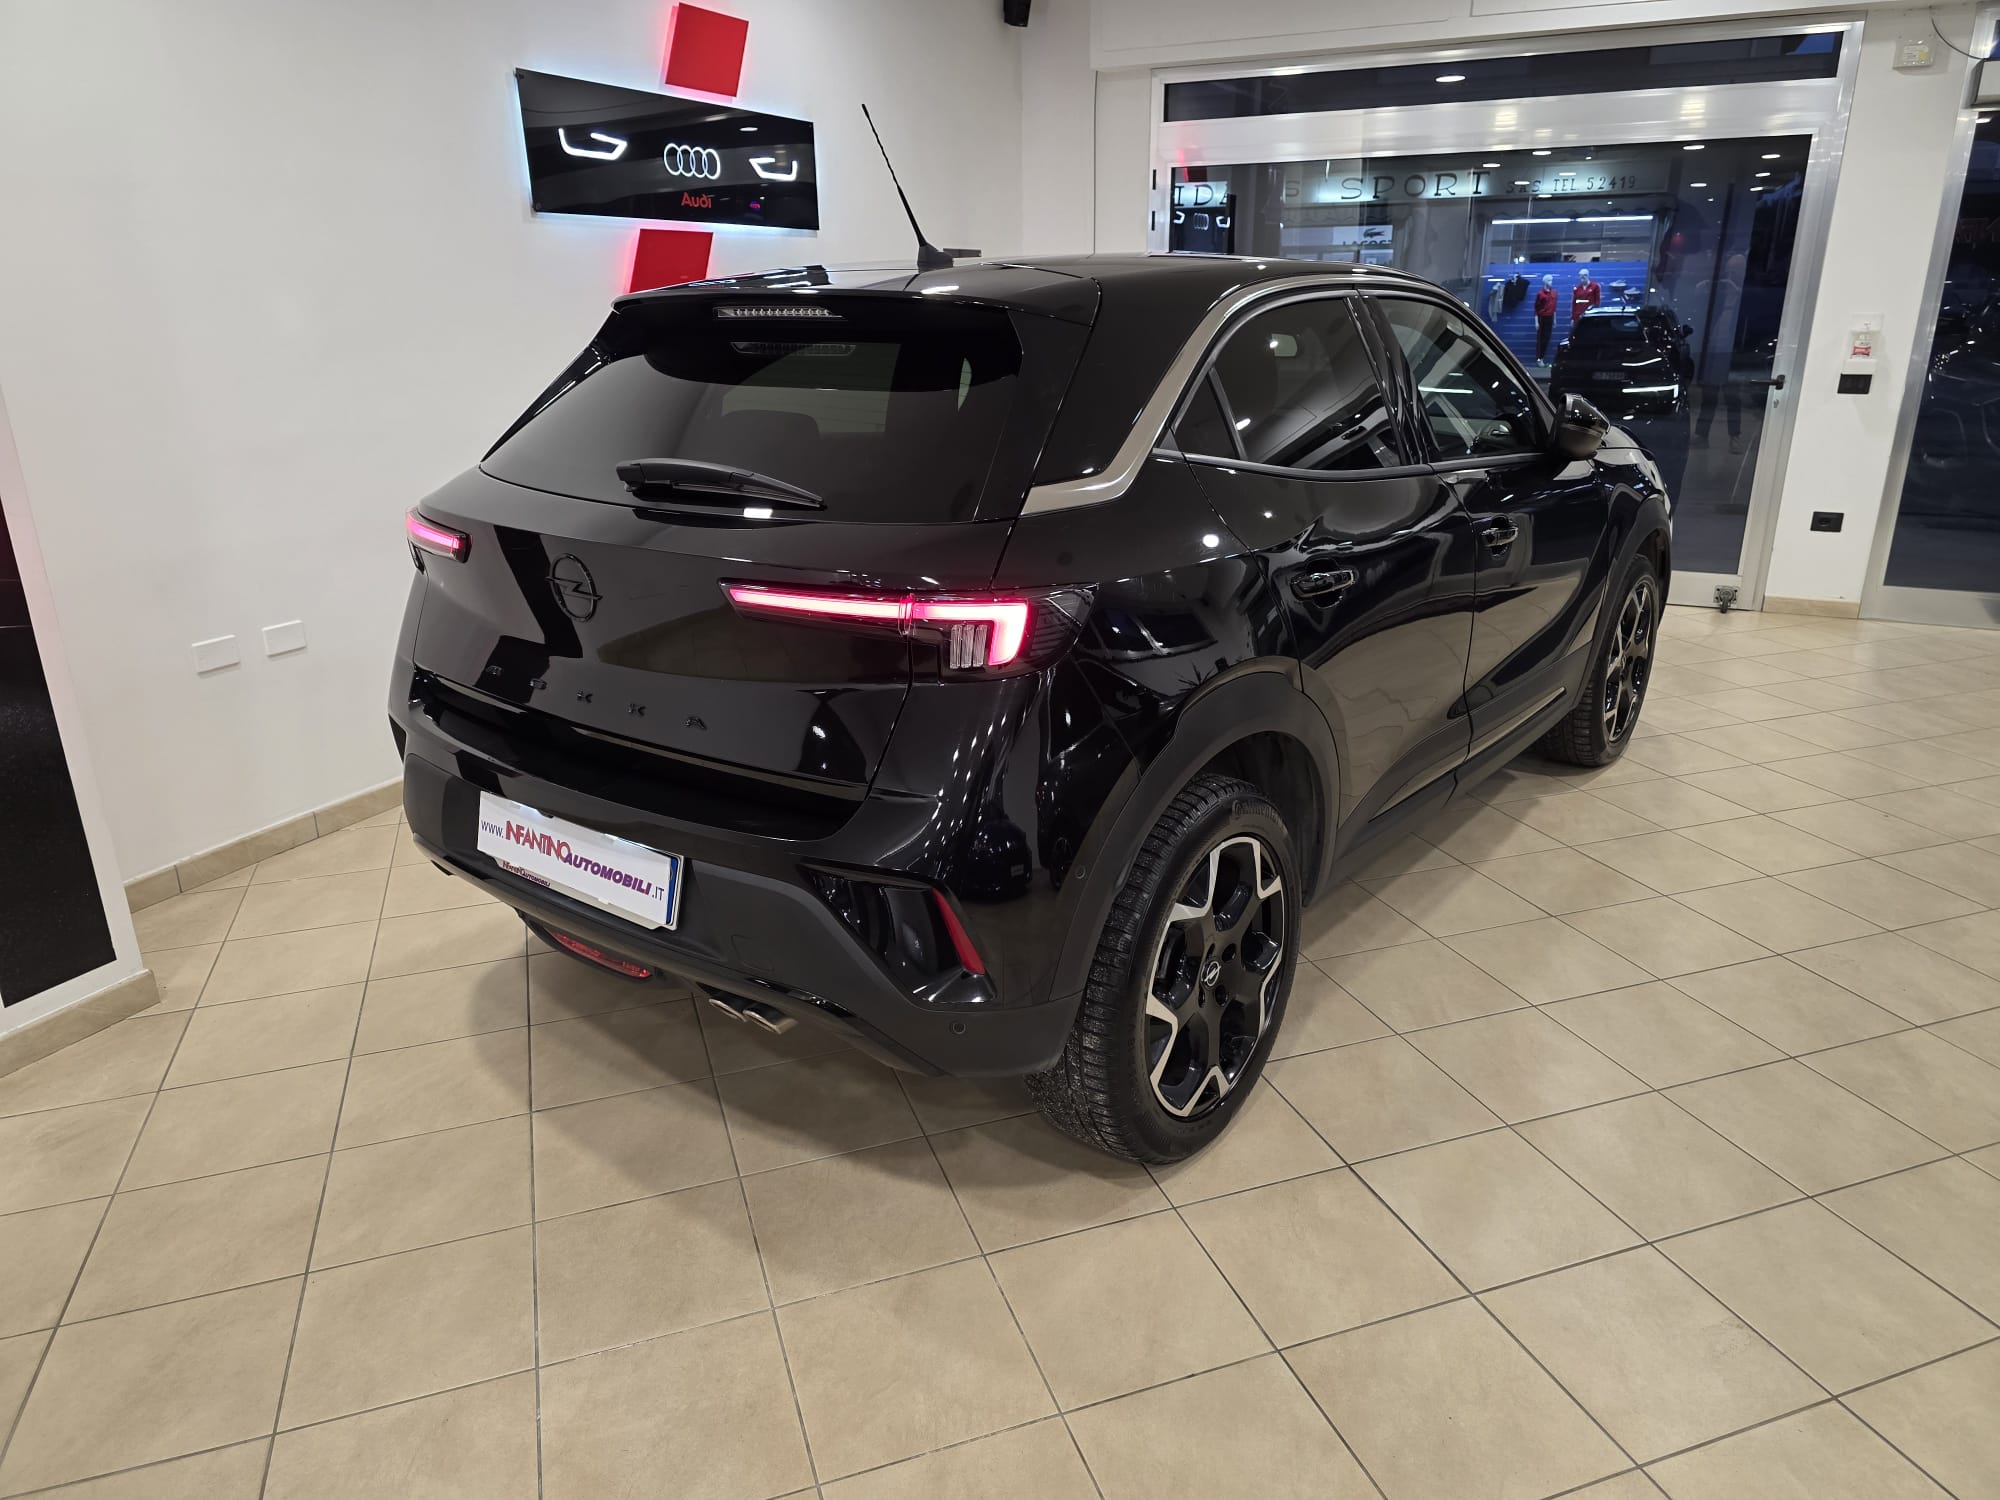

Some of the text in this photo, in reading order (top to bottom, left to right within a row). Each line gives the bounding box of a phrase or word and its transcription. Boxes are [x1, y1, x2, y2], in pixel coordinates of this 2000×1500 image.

[1341, 171, 1491, 200] SPORT
[1587, 176, 1636, 191] 52419
[681, 191, 712, 209] Audi
